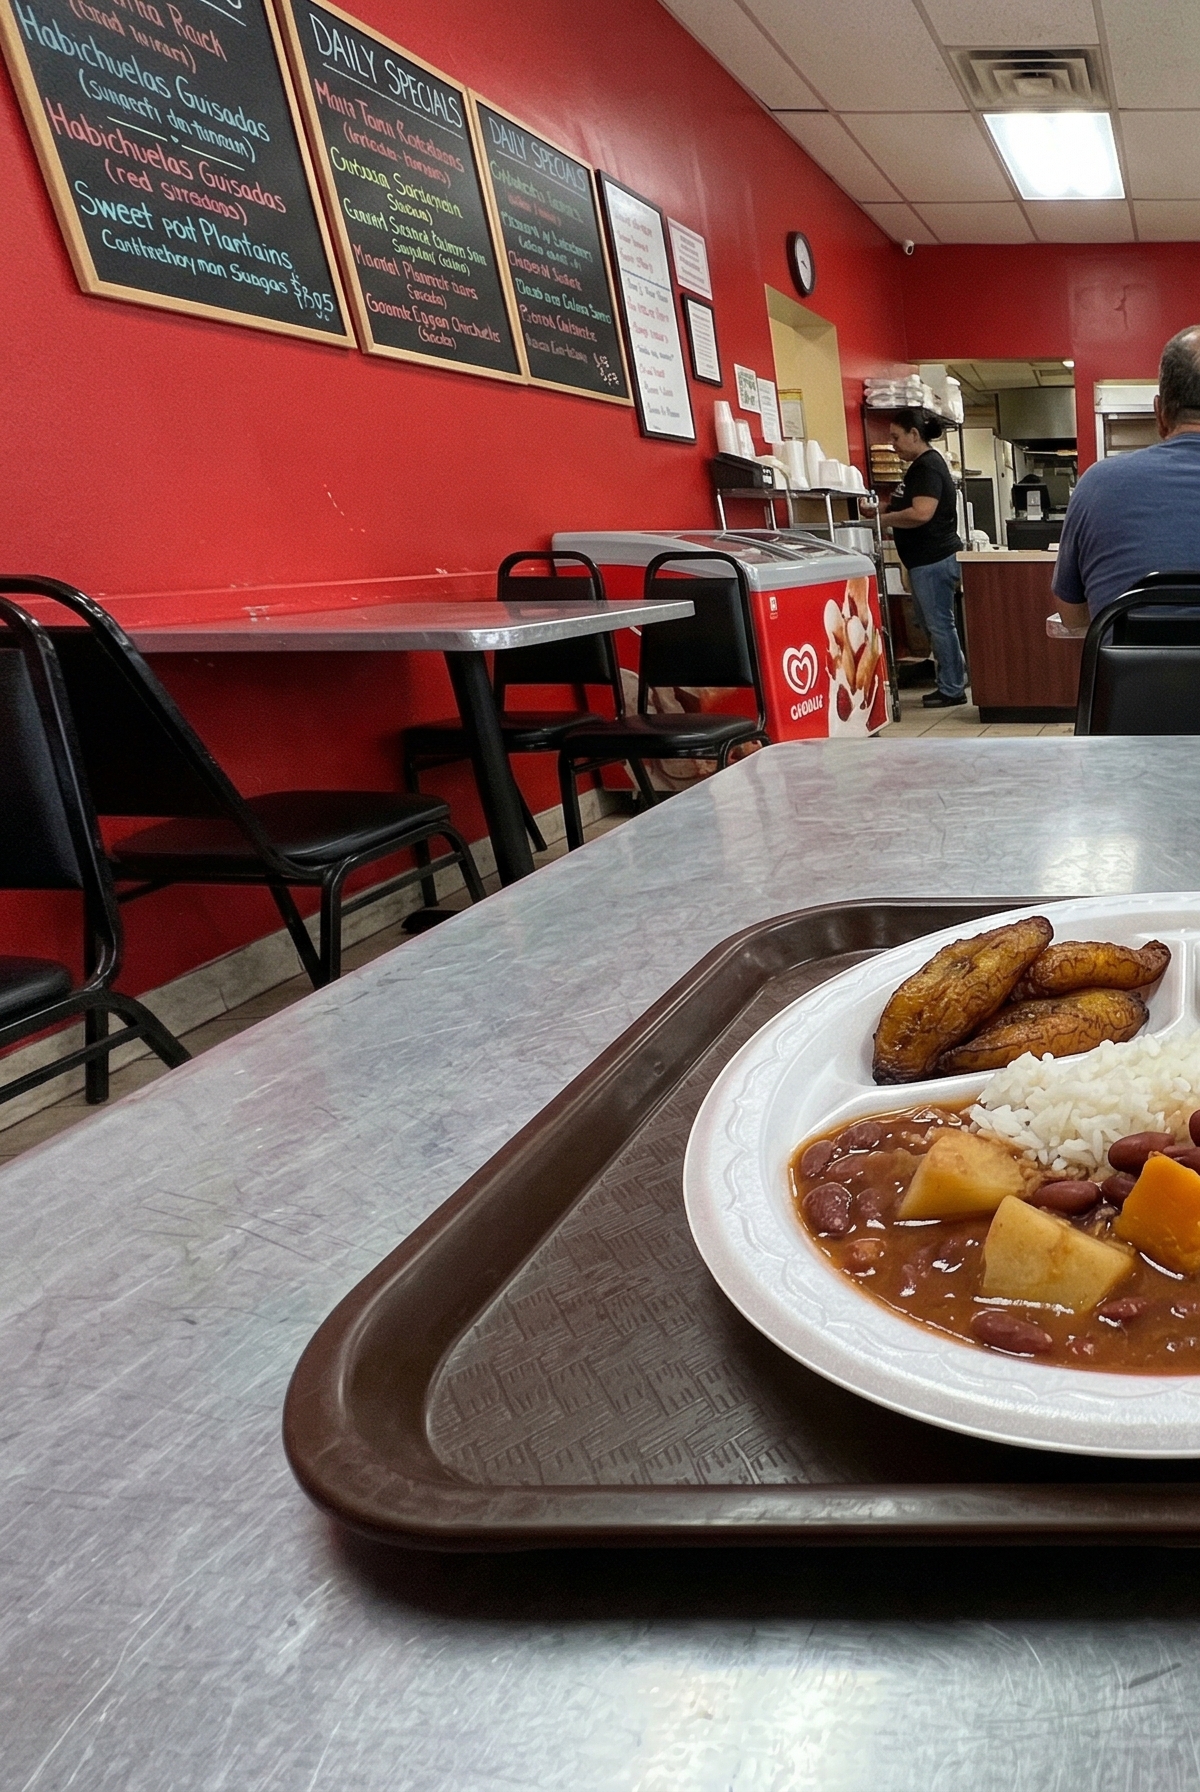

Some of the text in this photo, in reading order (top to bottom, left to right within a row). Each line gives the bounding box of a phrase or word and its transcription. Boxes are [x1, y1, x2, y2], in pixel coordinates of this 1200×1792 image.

[15, 0, 271, 142] Habichuelas Guisadas
[309, 13, 462, 128] DAILY SPECIALS
[45, 97, 194, 180] Habichuelas
[199, 161, 287, 213] Guisadas
[105, 158, 153, 193] (red
[488, 117, 526, 161] DAILY
[531, 141, 587, 192] SPECIALS
[75, 180, 154, 231] Sweet
[199, 217, 293, 270] Plantains
